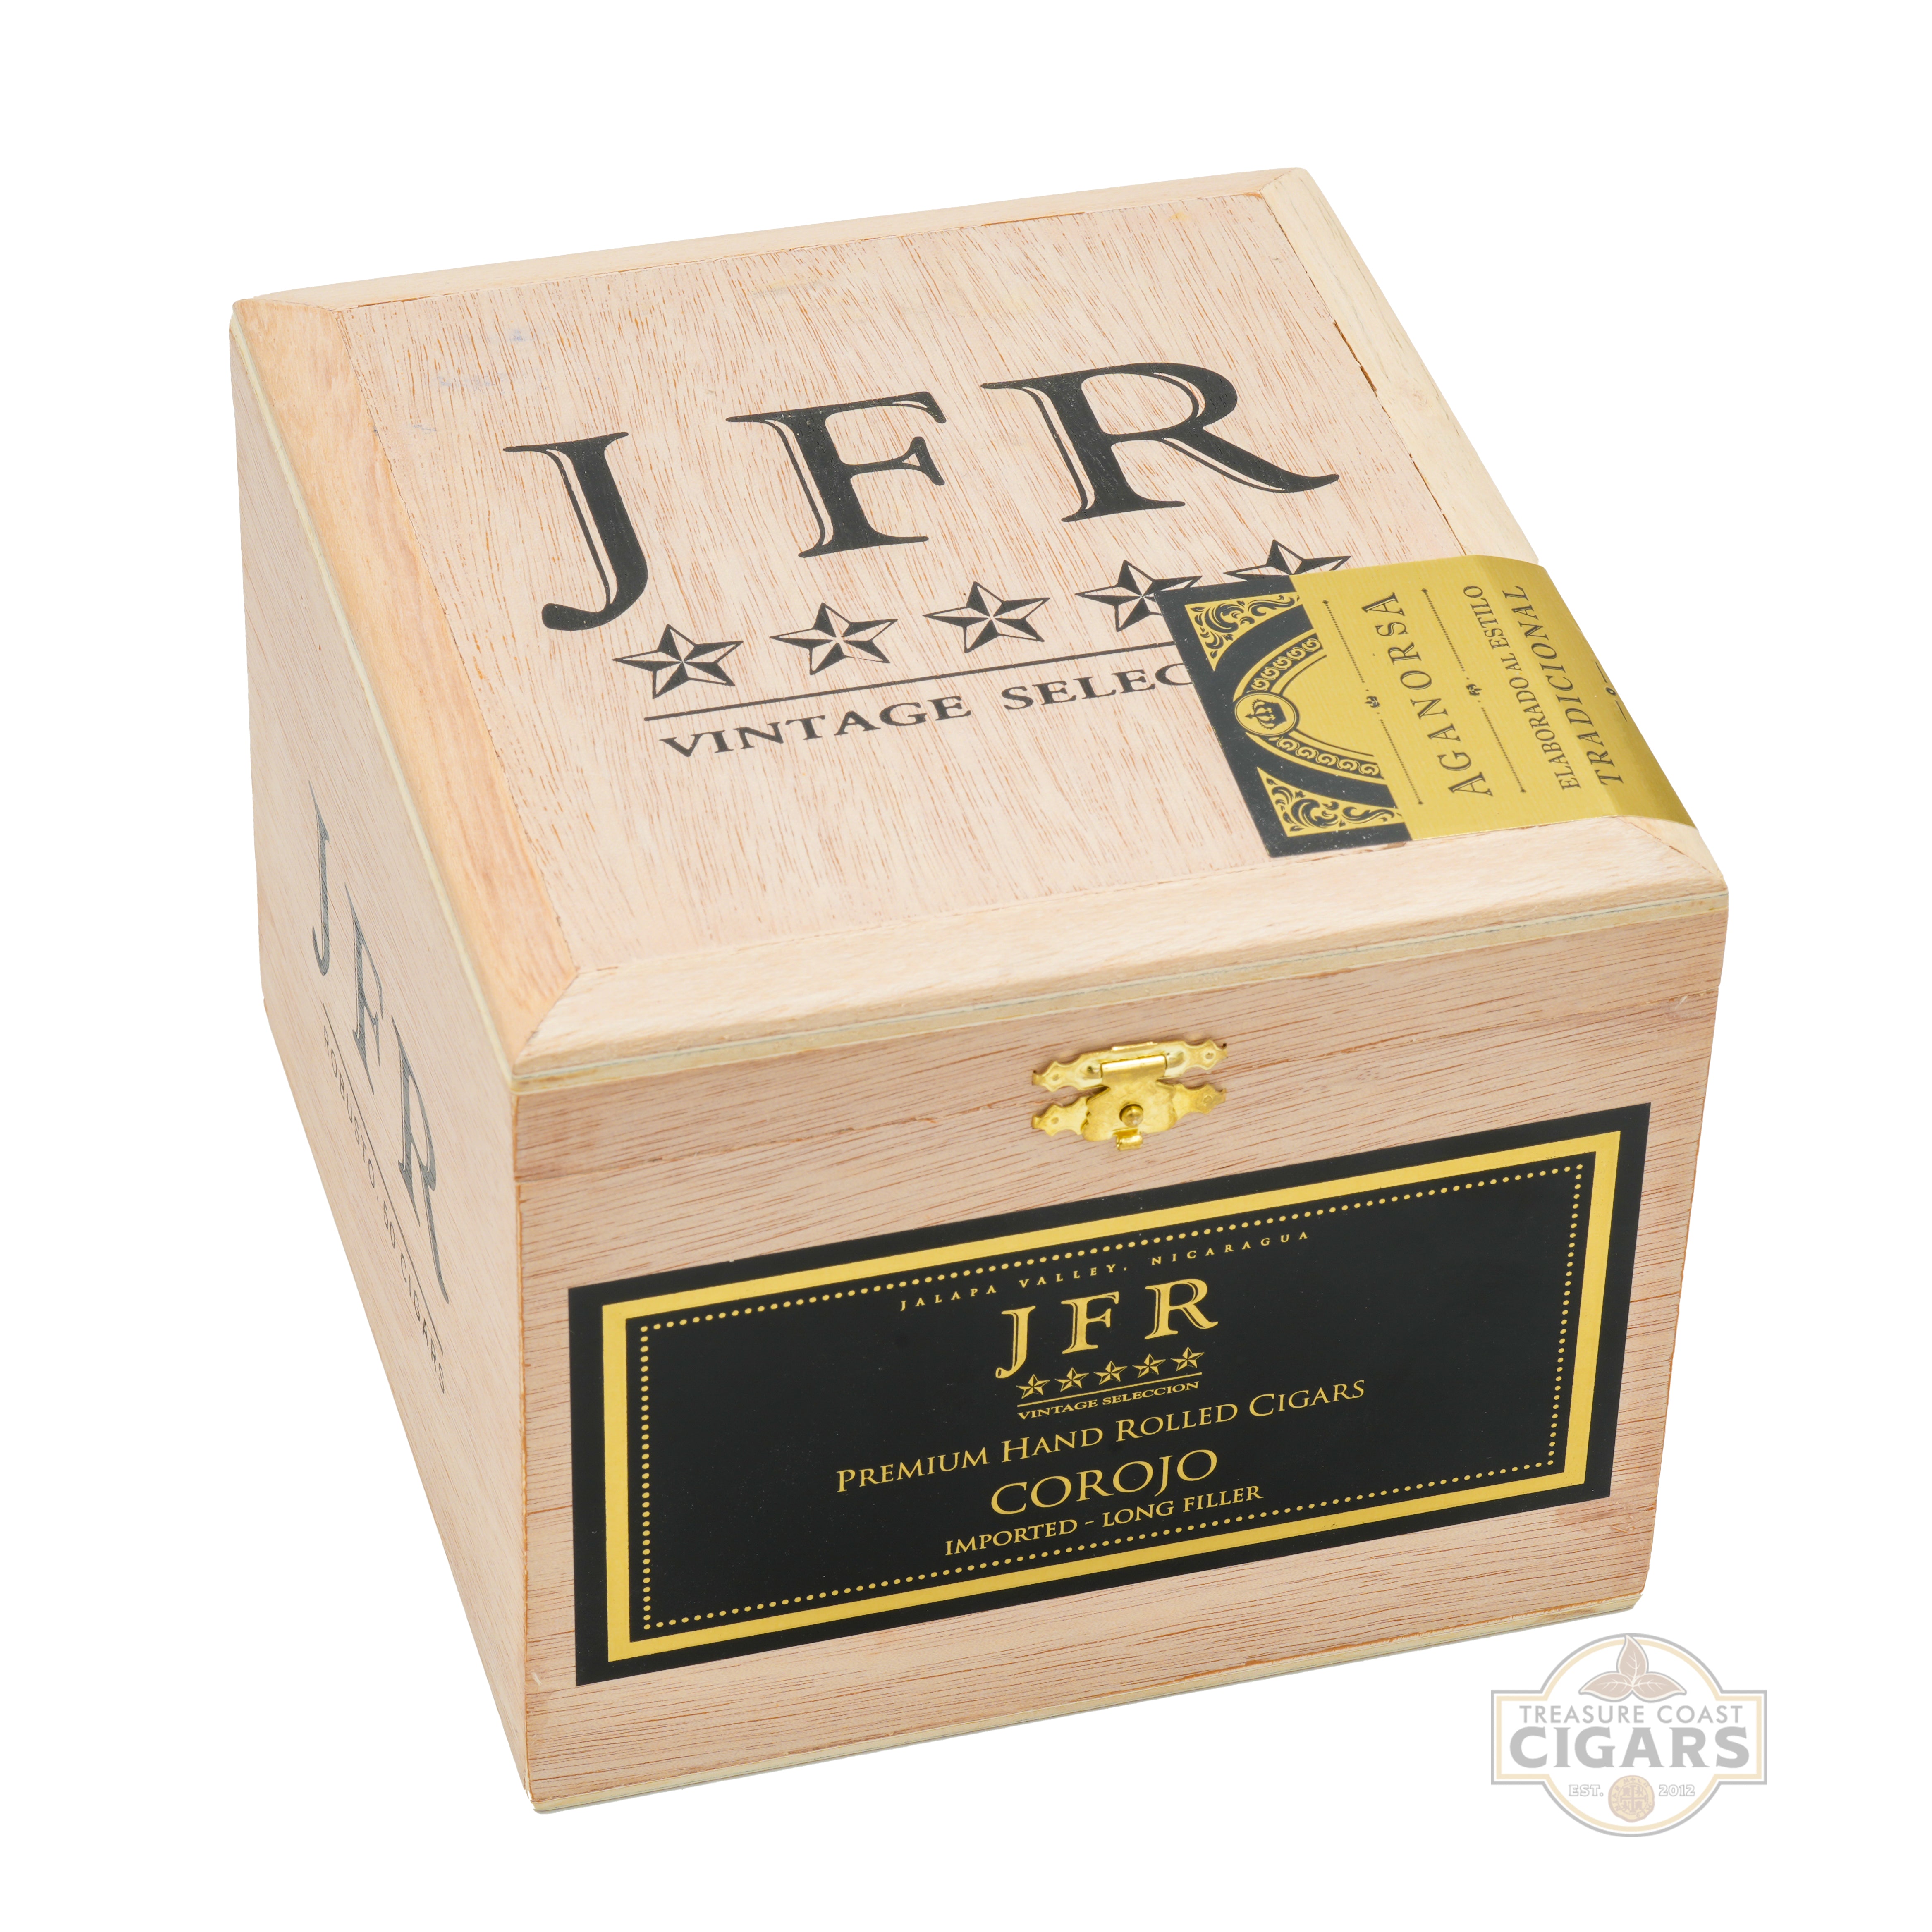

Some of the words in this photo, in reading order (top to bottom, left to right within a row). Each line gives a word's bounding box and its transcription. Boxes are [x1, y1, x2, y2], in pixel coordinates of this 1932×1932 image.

[503, 361, 1340, 632] JFR
[1463, 585, 1511, 650] ESTILO
[1501, 653, 1522, 672] AL
[659, 696, 973, 758] VINTAGE
[1361, 592, 1493, 798] AGANORSA
[1502, 585, 1624, 786] TRADICIONAL
[1509, 677, 1582, 791] ELABORADO
[383, 1200, 395, 1249] 50
[401, 1252, 445, 1394] CIGARS
[900, 1285, 997, 1311] JALAPA
[1151, 1231, 1310, 1266] NICARAGUA
[995, 1278, 1218, 1379] JFR
[836, 1447, 989, 1493] PREMIUM
[1001, 1427, 1104, 1463] HAND
[1115, 1403, 1239, 1444] ROLLED
[1248, 1380, 1366, 1417] CIGARS
[1017, 1399, 1098, 1420] VINTAGE
[1102, 1381, 1200, 1406] SELECCION
[945, 1518, 1078, 1557] IMPORTED
[1102, 1500, 1175, 1527] LONG
[1183, 1485, 1264, 1513] FILLER
[990, 1449, 1217, 1516] COROJO
